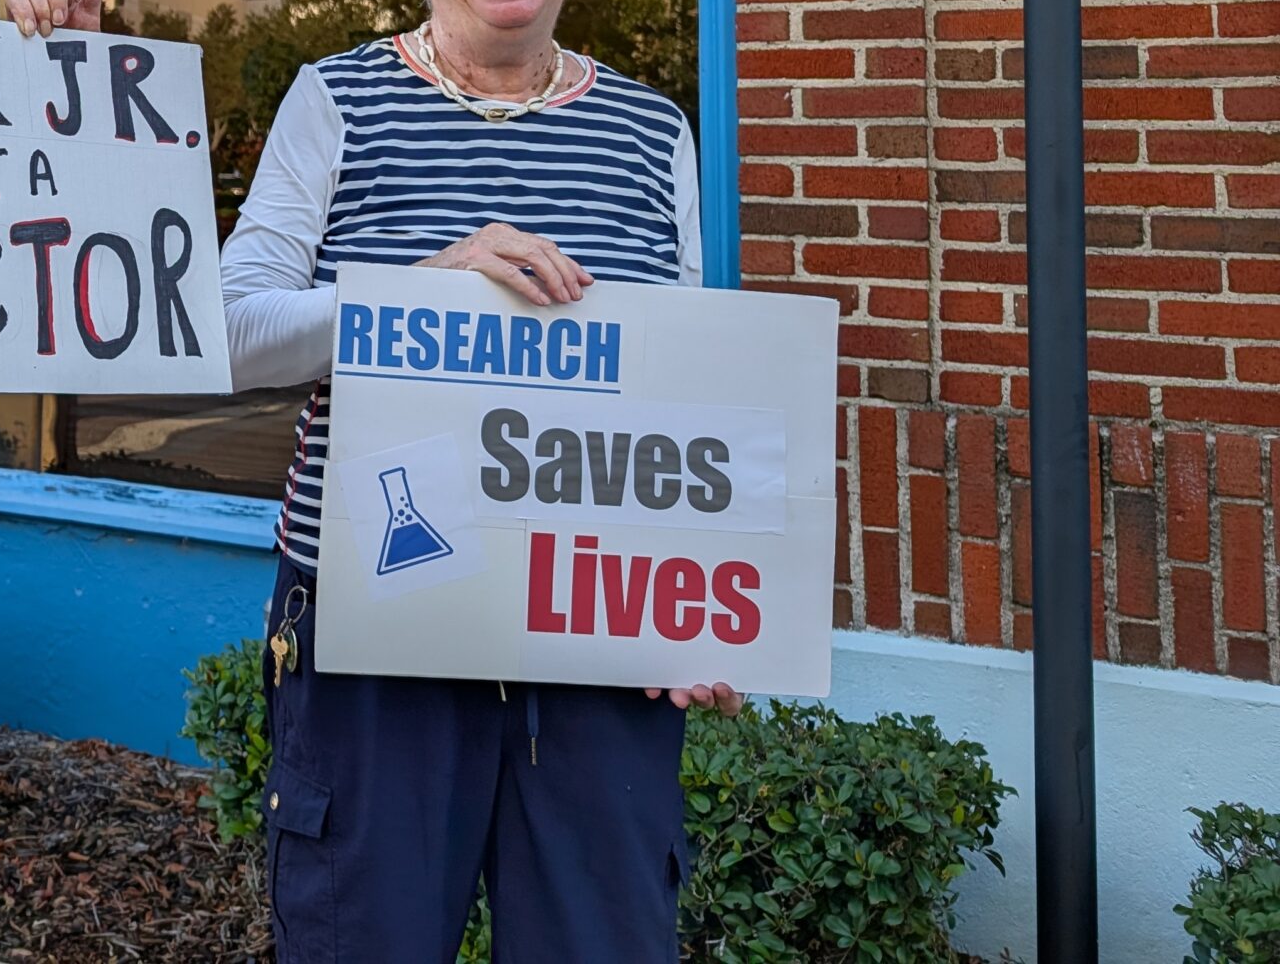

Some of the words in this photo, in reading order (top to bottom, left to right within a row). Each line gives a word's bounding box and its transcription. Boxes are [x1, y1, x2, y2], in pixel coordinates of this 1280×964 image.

[44, 40, 201, 149] JR.
[29, 148, 59, 197] A
[337, 302, 621, 384] RESEARCH
[480, 407, 733, 514] Saves
[526, 531, 762, 646] Lives
